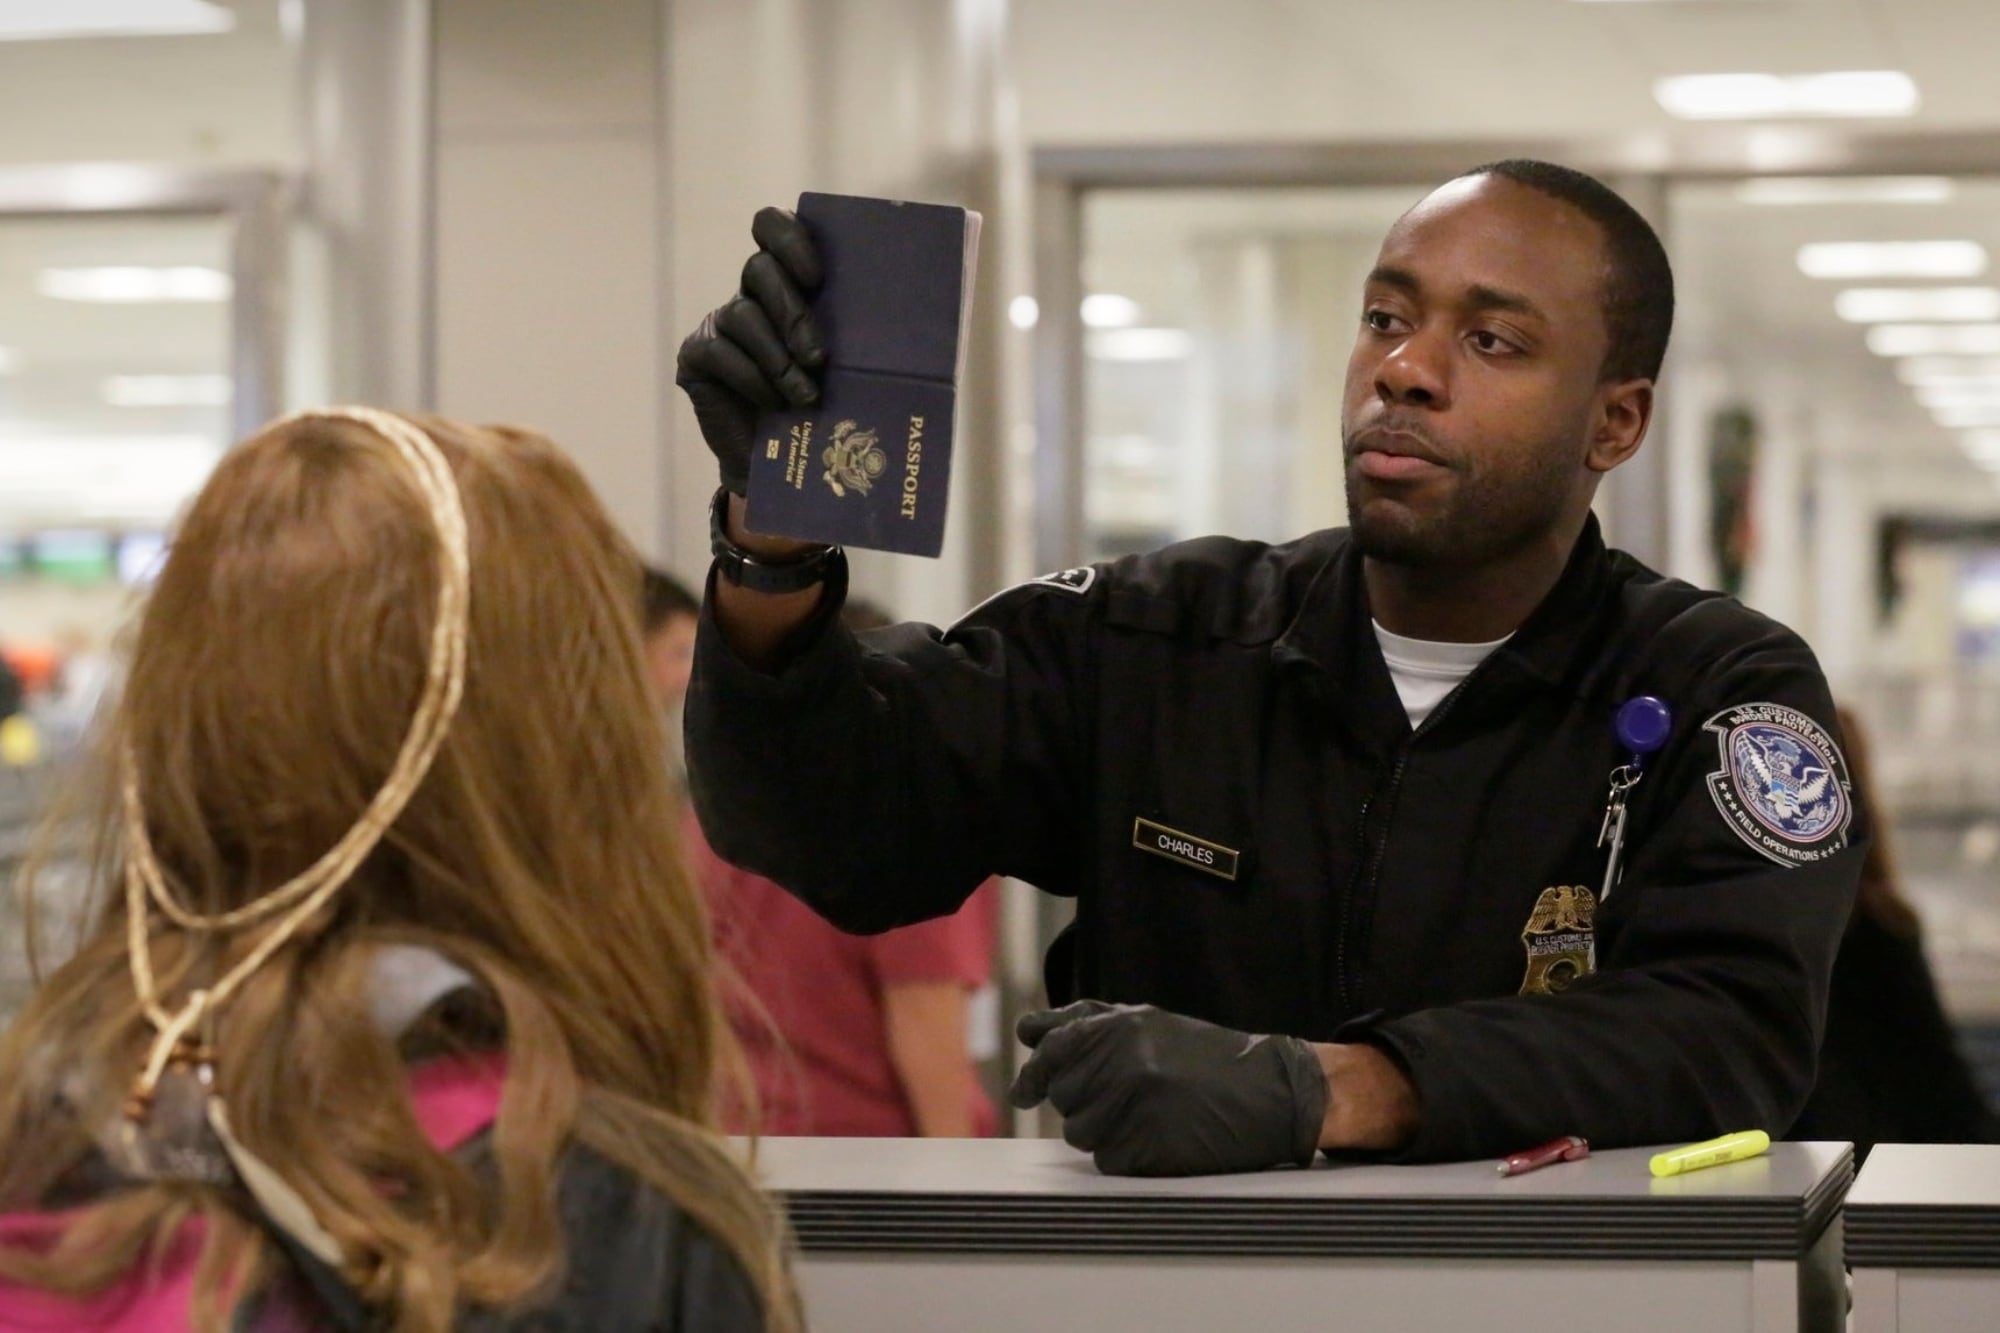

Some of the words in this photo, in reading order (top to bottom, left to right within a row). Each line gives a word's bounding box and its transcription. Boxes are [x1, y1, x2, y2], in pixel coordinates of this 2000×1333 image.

[790, 425, 801, 439] of
[800, 421, 812, 457] United
[786, 438, 798, 482] America
[795, 458, 808, 490] States
[901, 415, 924, 520] PASSPORT
[1759, 706, 1813, 732] CUSTOMS
[1730, 713, 1772, 724] BORDER
[1775, 715, 1837, 765] PROTECTION
[1158, 834, 1214, 865] CHARLES
[1735, 810, 1761, 839] FIELD
[1763, 836, 1820, 861] OPERATIONS
